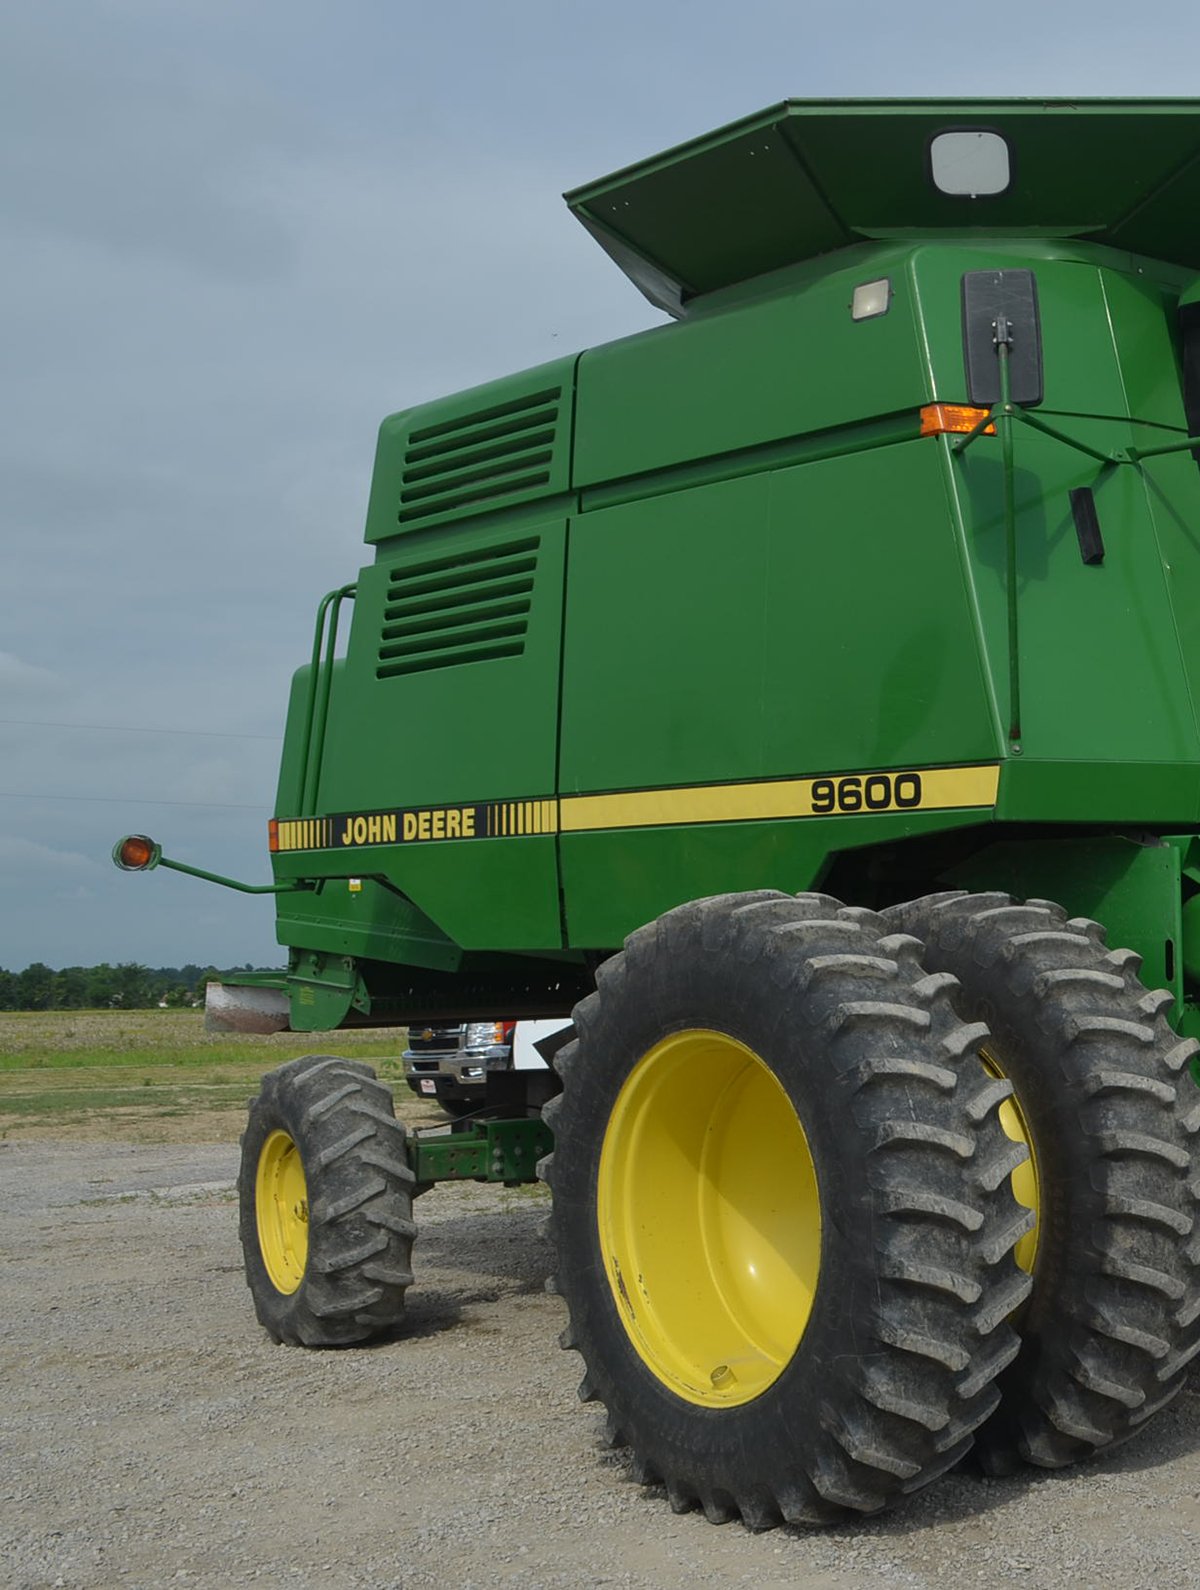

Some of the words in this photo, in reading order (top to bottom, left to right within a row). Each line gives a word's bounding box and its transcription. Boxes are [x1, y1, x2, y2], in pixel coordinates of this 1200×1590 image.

[811, 773, 921, 813] 9600
[342, 814, 396, 845] JOHN
[403, 808, 476, 841] DEERE
